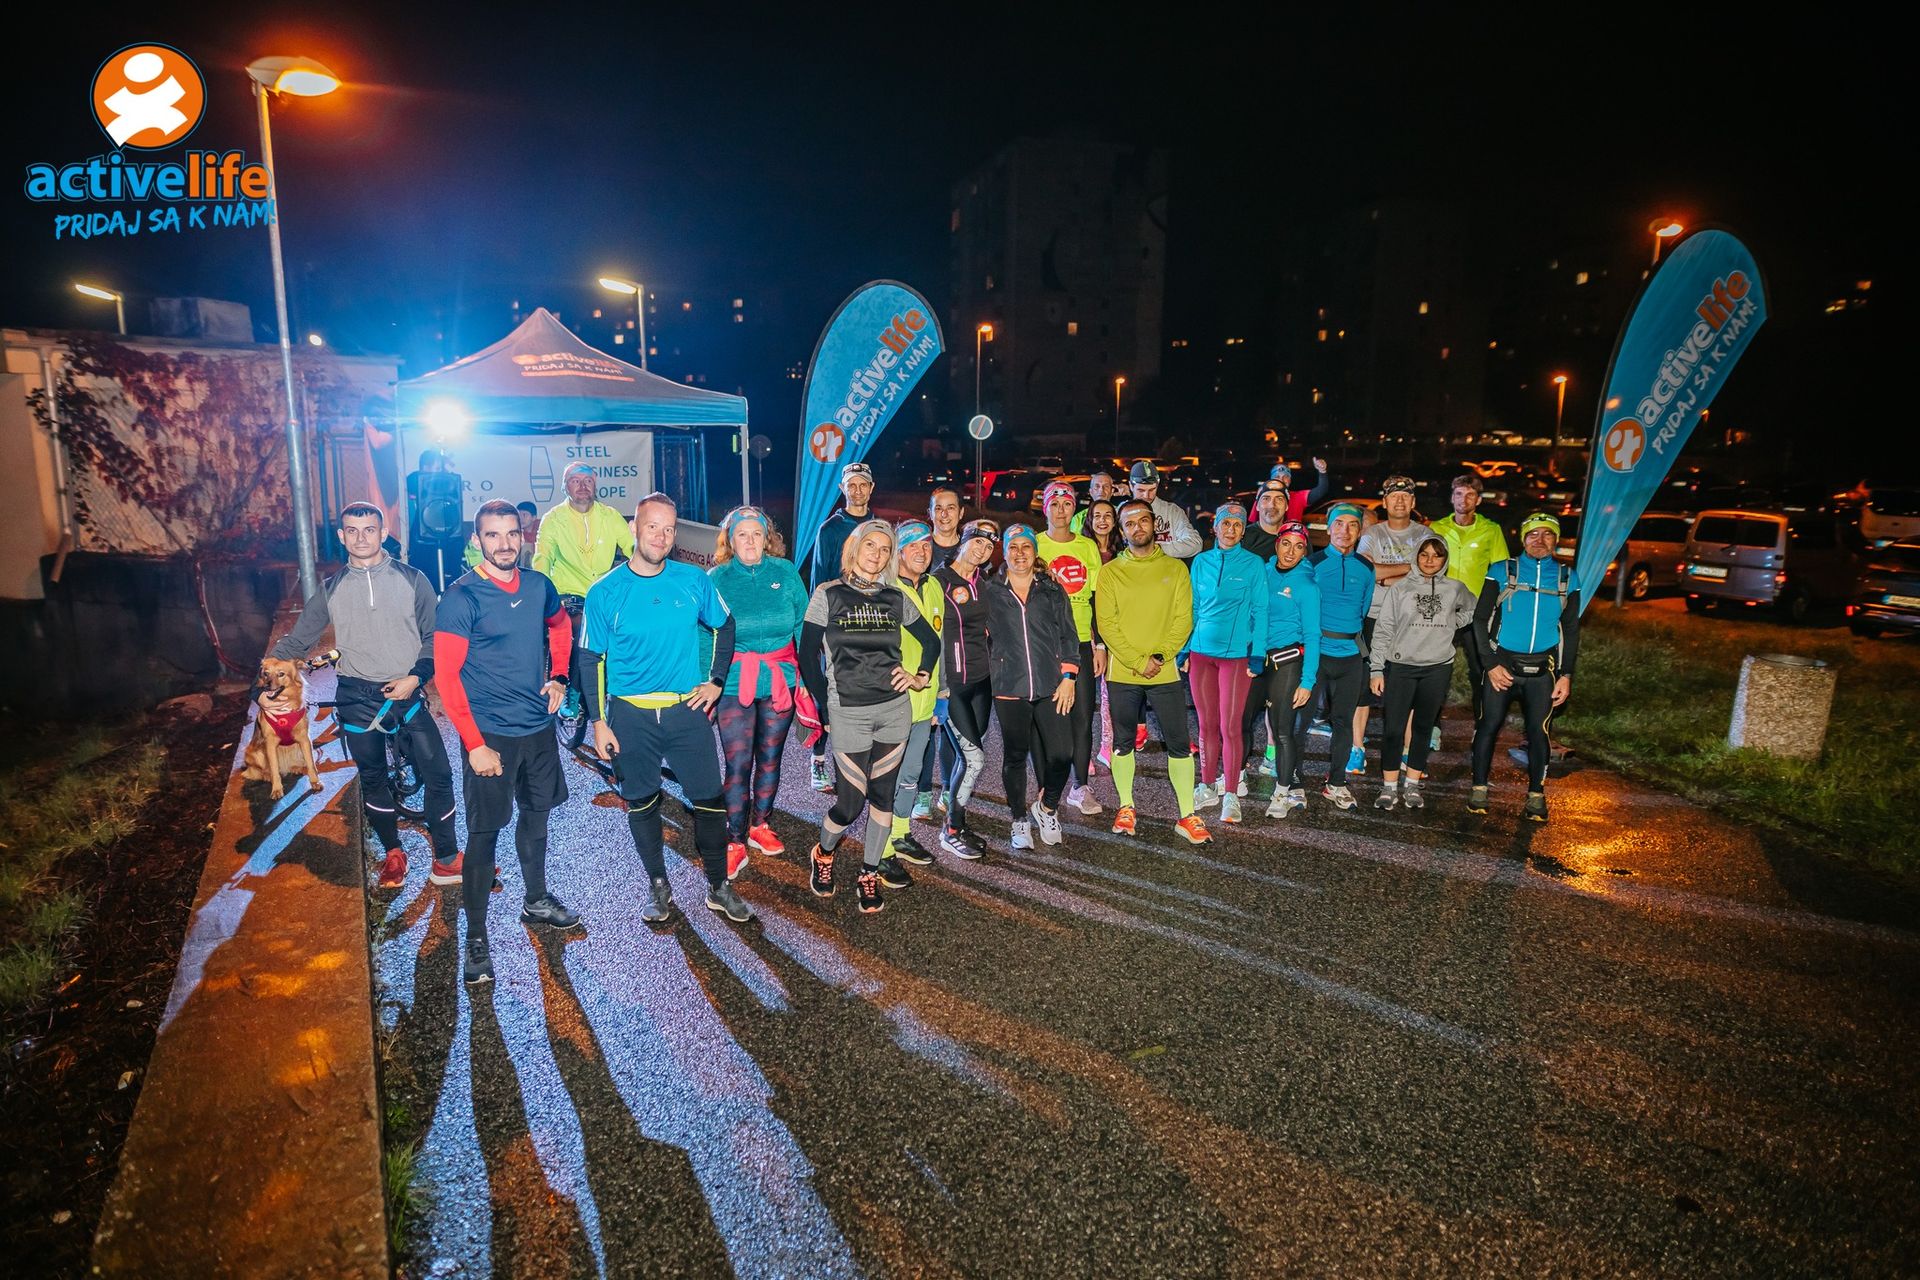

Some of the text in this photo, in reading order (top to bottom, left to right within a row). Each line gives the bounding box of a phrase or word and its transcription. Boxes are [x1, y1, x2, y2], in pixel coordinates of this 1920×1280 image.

[523, 362, 565, 372] PRIDAJ
[567, 362, 581, 371] SA
[833, 307, 929, 428] activelife
[1635, 270, 1751, 427] activelife
[850, 398, 888, 446] PRIDAJ
[882, 379, 901, 402] SA
[896, 366, 910, 383] K
[1652, 388, 1698, 455] PRIDAJ
[1694, 361, 1717, 391] SA
[1711, 343, 1727, 363] K
[566, 446, 611, 458] STEEL
[592, 465, 638, 478] SINESS
